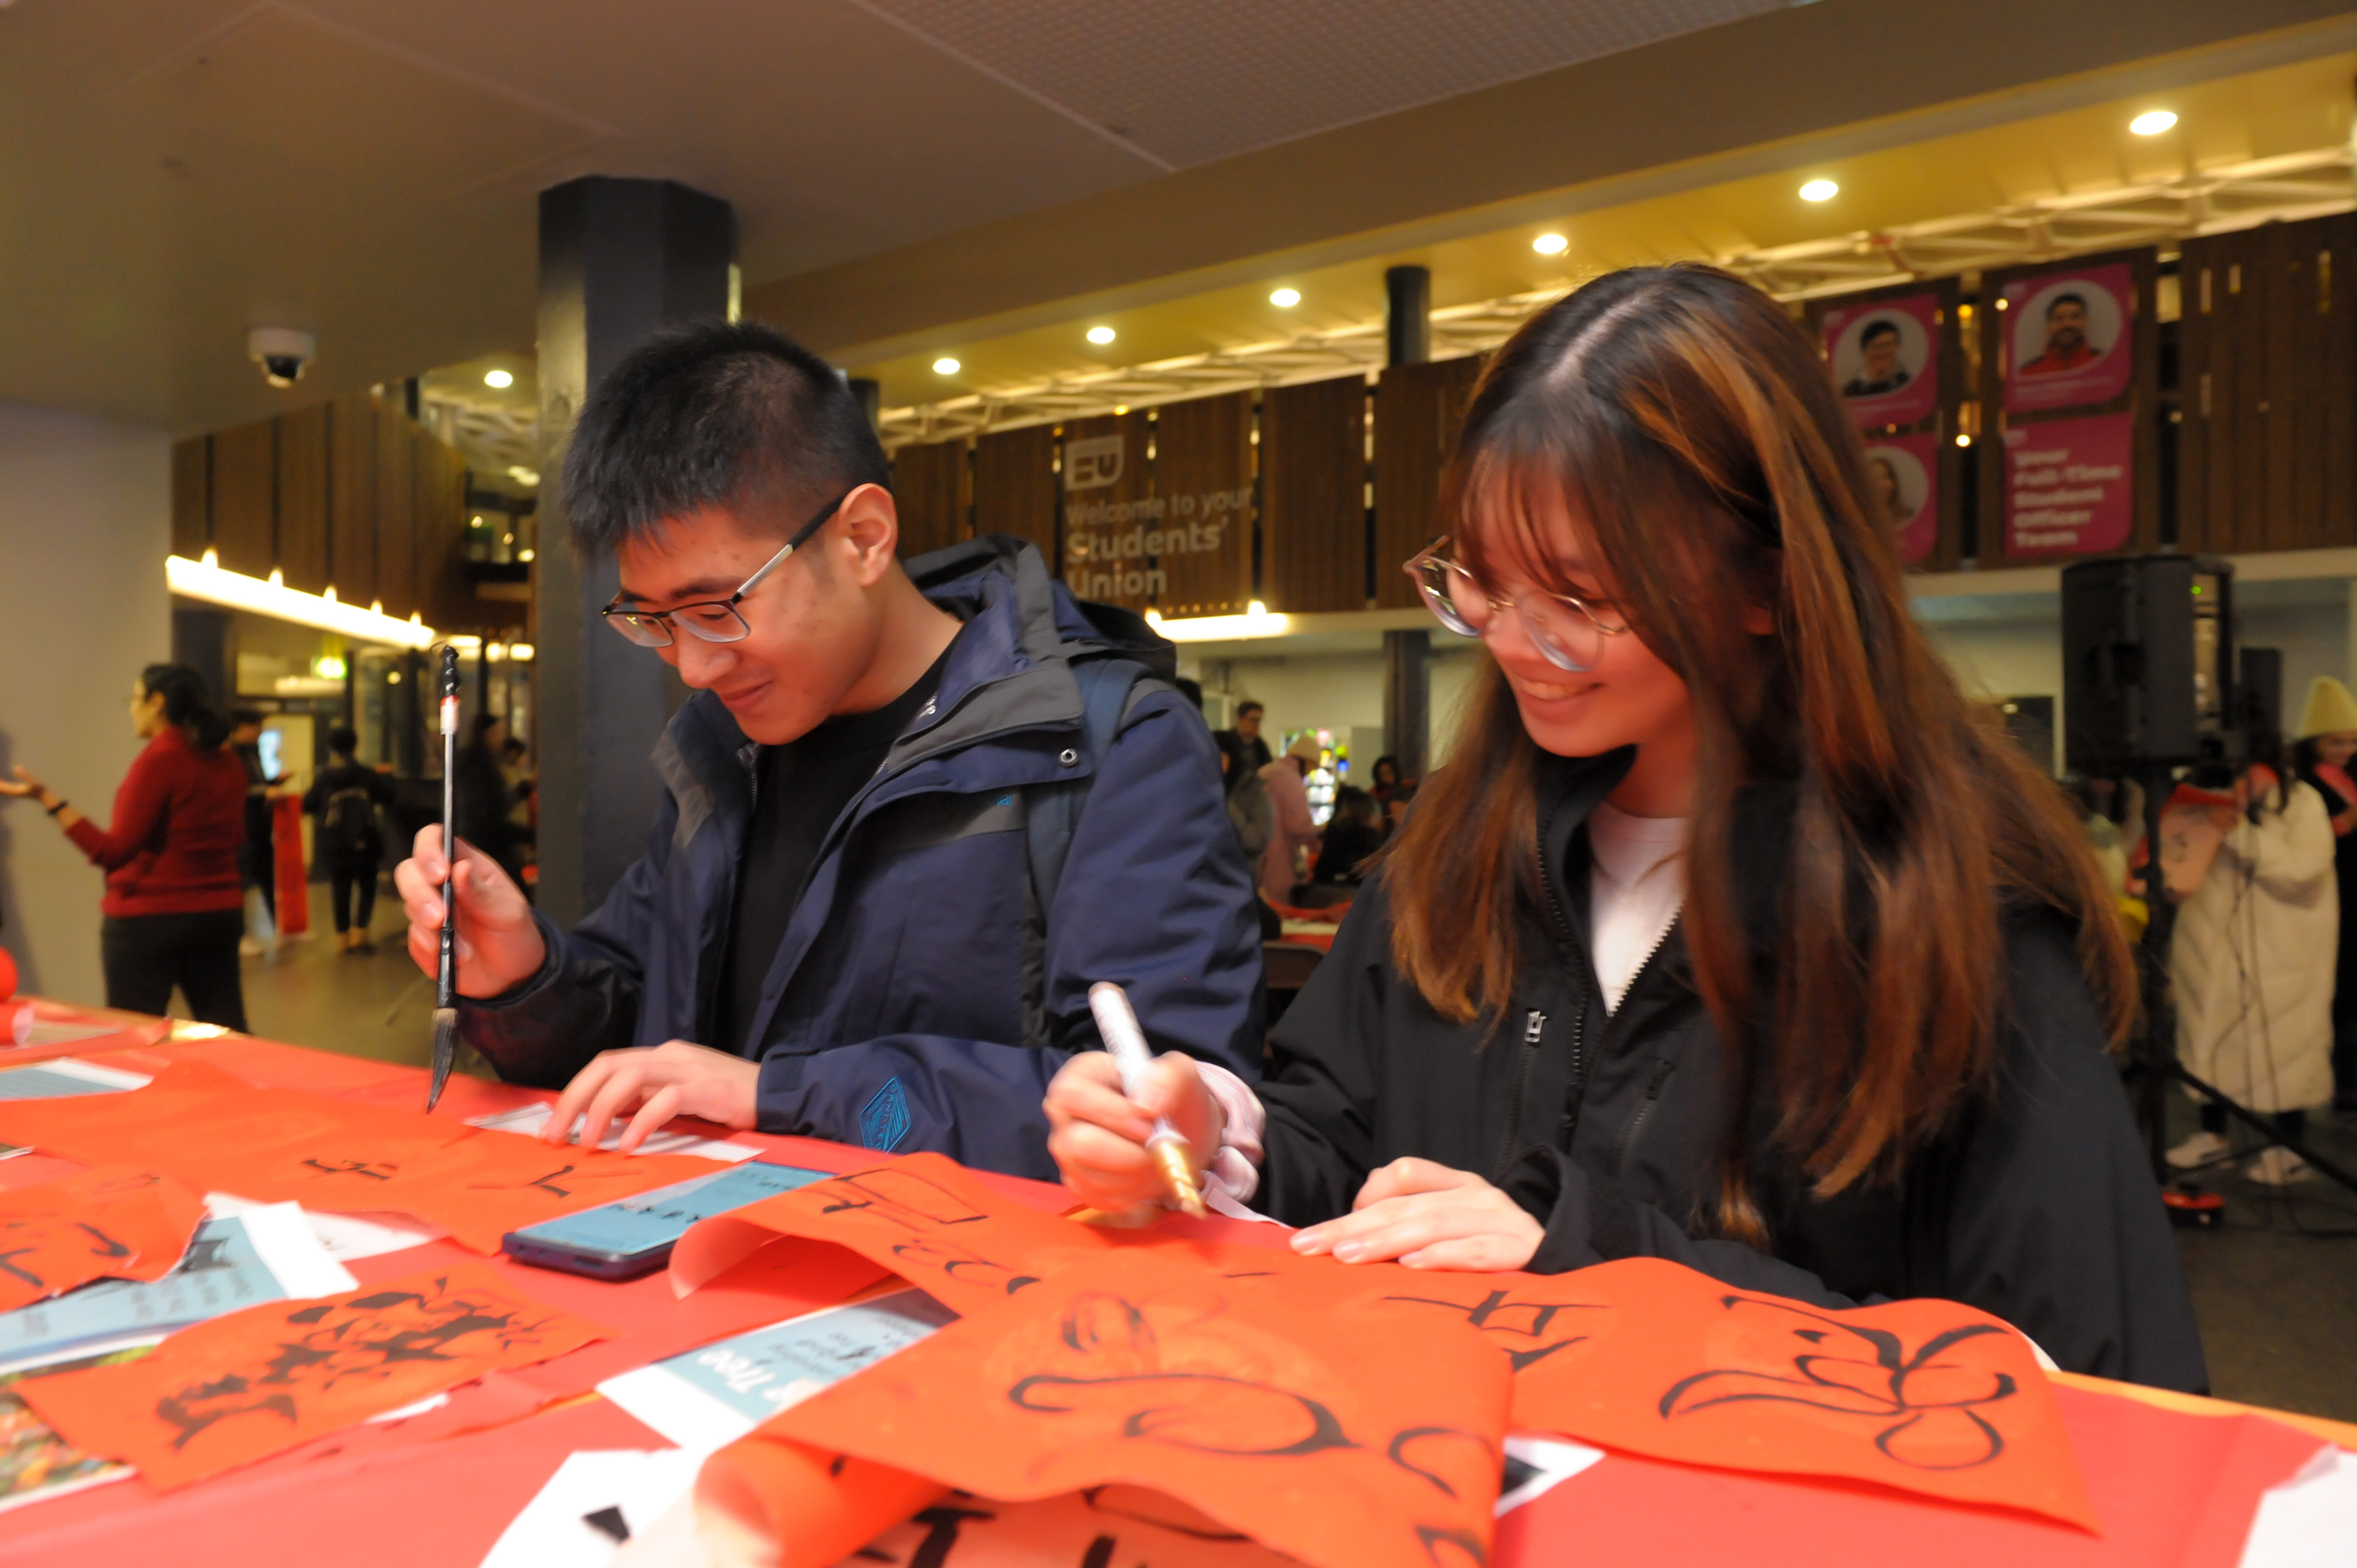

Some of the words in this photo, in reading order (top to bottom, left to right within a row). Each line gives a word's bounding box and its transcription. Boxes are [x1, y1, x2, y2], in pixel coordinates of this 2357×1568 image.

[1065, 498, 1165, 526] Welcome
[1171, 494, 1196, 516] to
[1201, 487, 1254, 518] your
[2014, 485, 2104, 507] Student
[2013, 508, 2093, 528] Officer
[1066, 515, 1229, 564] Students'
[1067, 564, 1168, 599] Union
